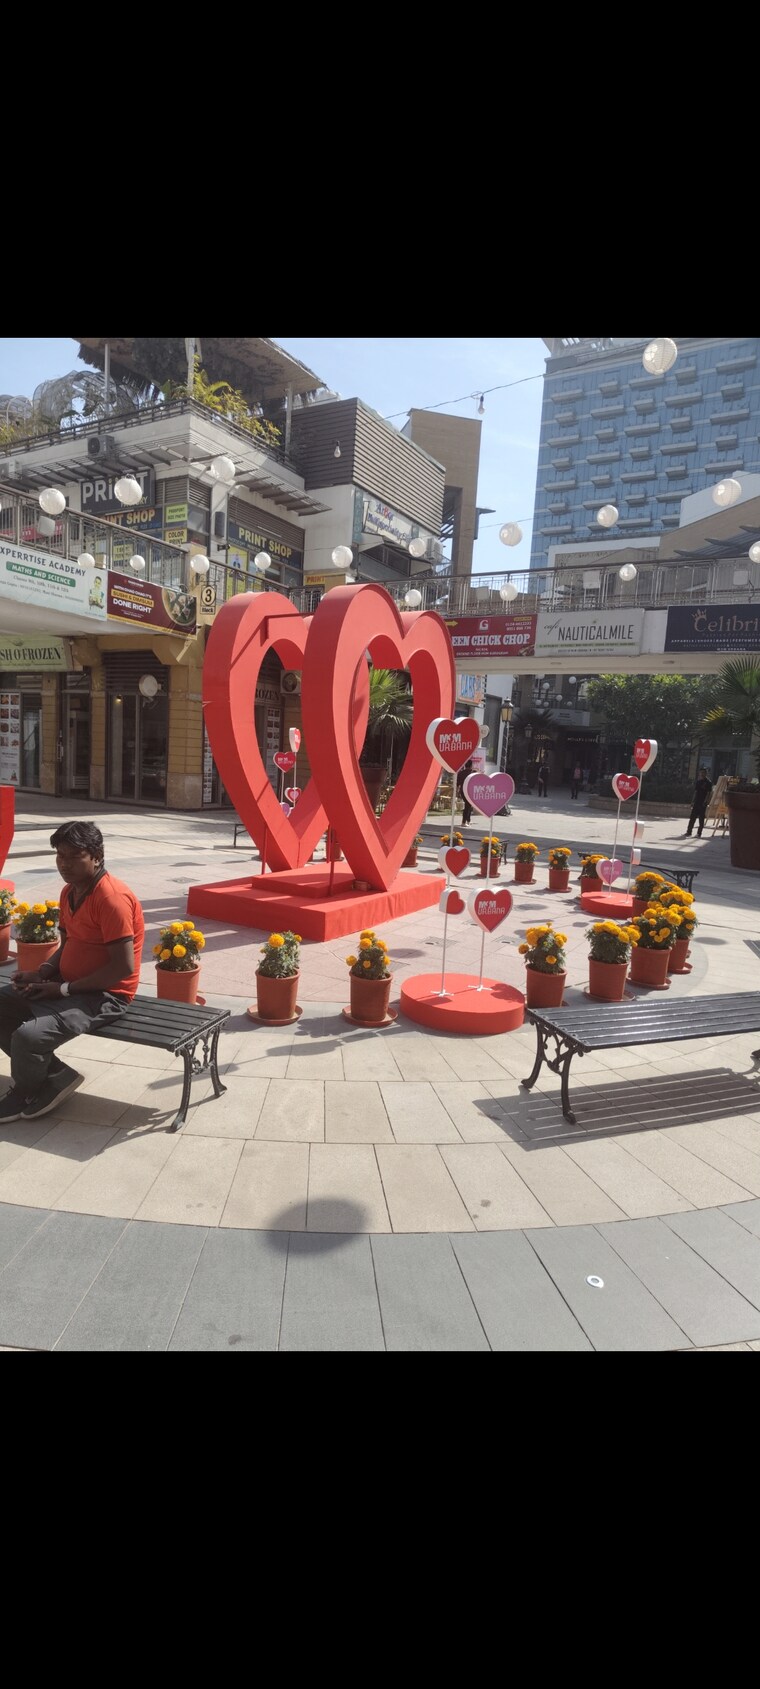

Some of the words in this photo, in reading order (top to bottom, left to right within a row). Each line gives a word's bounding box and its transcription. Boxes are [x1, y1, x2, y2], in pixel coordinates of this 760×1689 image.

[126, 509, 155, 525] SHOP
[238, 527, 267, 549] PRINT
[268, 540, 292, 558] SHOP
[11, 564, 33, 576] MATHS
[33, 571, 47, 579] AND
[48, 574, 71, 585] SCIENCE
[48, 560, 86, 577] ACADEMY
[205, 588, 212, 606] 3
[113, 598, 132, 608] DONE
[132, 603, 152, 613] RIGHT
[471, 635, 501, 646] CHICK
[503, 634, 531, 645] CHOP
[558, 625, 634, 641] NAUTICALMILE
[439, 741, 472, 752] URBANA
[473, 792, 507, 800] URBANA
[477, 907, 505, 915] URBANA
